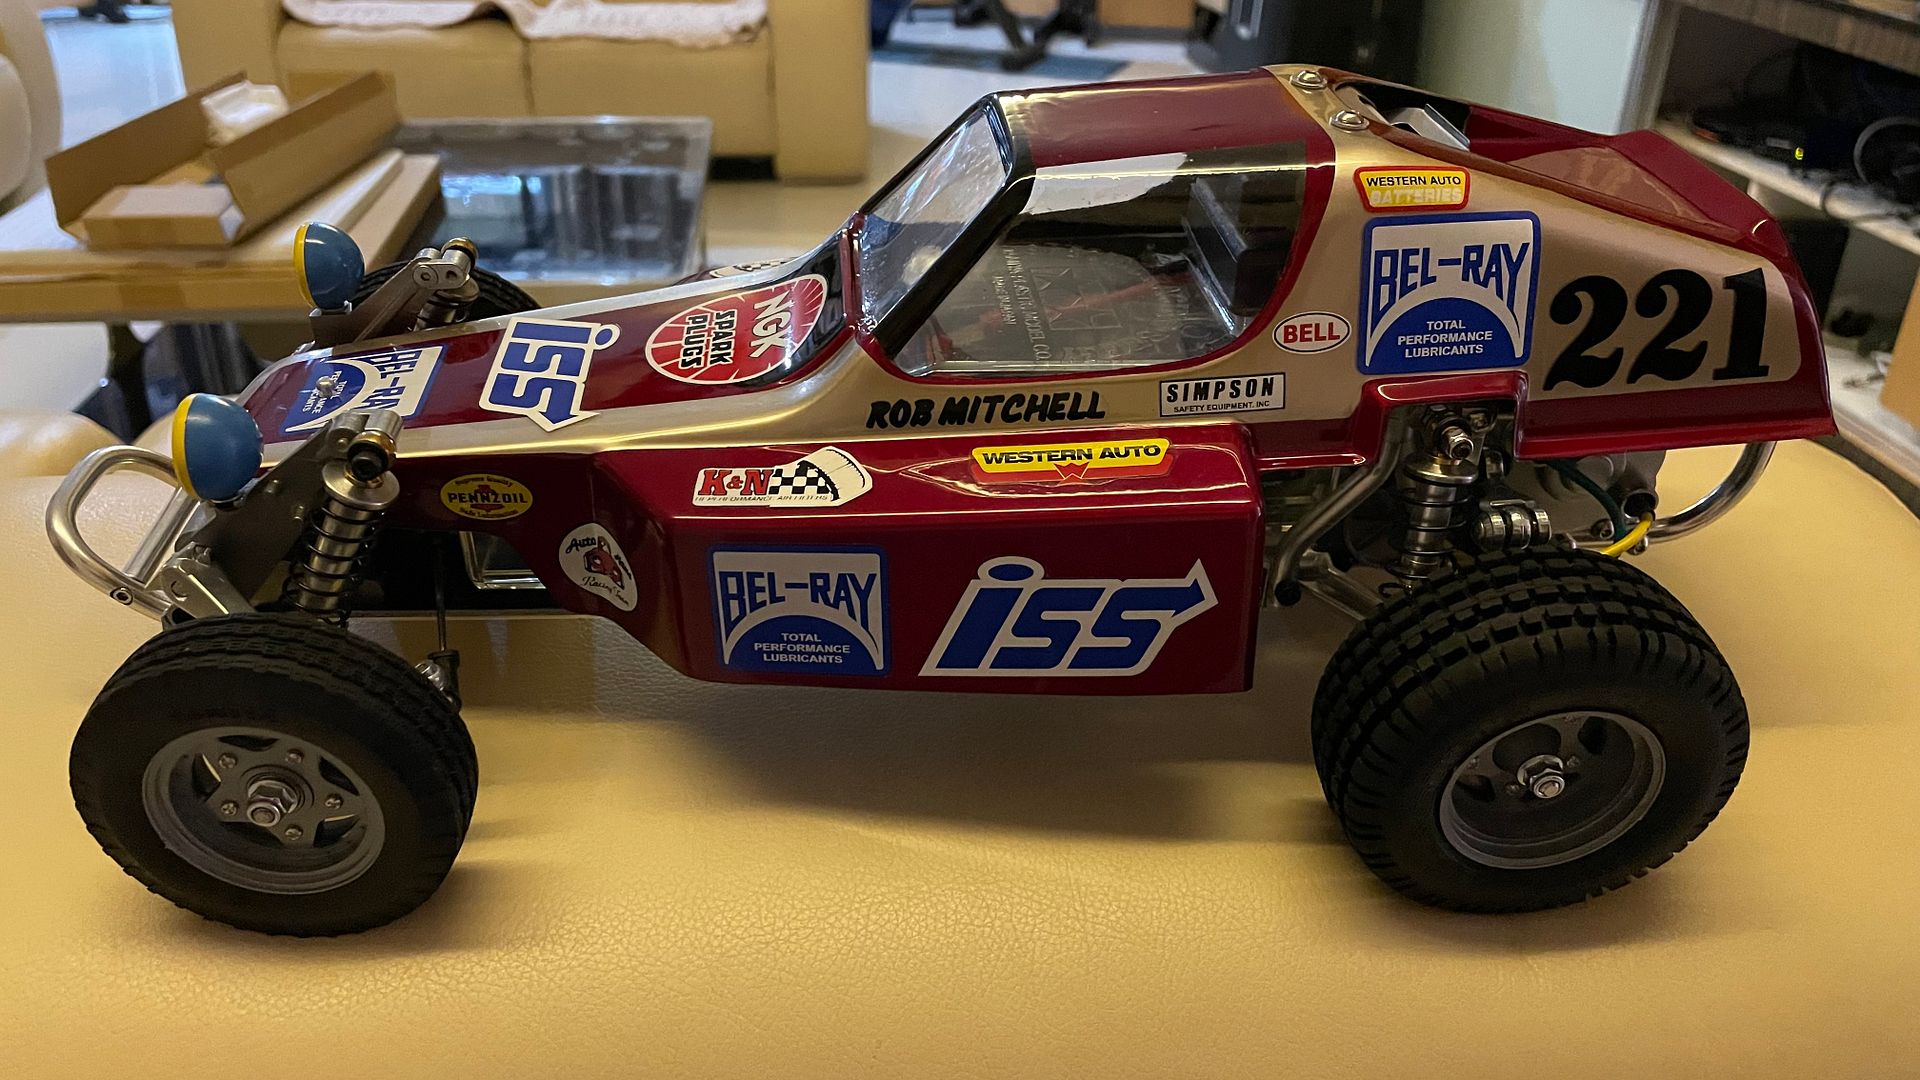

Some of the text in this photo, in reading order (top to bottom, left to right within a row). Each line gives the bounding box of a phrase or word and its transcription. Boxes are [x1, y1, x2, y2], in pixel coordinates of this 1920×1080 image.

[1366, 175, 1461, 187] WESTERN AUTO
[1370, 188, 1462, 204] BATTERIES
[1370, 242, 1531, 338] BEL-RAY
[750, 290, 792, 358] NGK
[1023, 311, 1046, 343] MODEL
[1282, 322, 1341, 344] BELL
[1426, 319, 1466, 331] TOTAL
[1542, 266, 1771, 392] 221
[678, 313, 705, 370] PLUGS
[710, 309, 738, 365] SPARK
[1397, 330, 1493, 346] PERFORMANCE
[1404, 344, 1484, 359] LUBRICANTS
[347, 349, 423, 411] BEL-RA
[1166, 376, 1275, 403] SIMPSON
[865, 389, 1107, 430] ROB MITCHELL
[1173, 404, 1205, 413] SAFETY
[982, 444, 1162, 465] WESTERN AUTO
[697, 469, 774, 496] K&N
[447, 492, 528, 504] PENNZOIL
[565, 537, 596, 554] Auto
[718, 571, 880, 653] BEL-RAY
[780, 632, 822, 642] TOTAL
[753, 642, 851, 654] PERFORMANCE
[762, 653, 843, 664] LUBRICANTS
